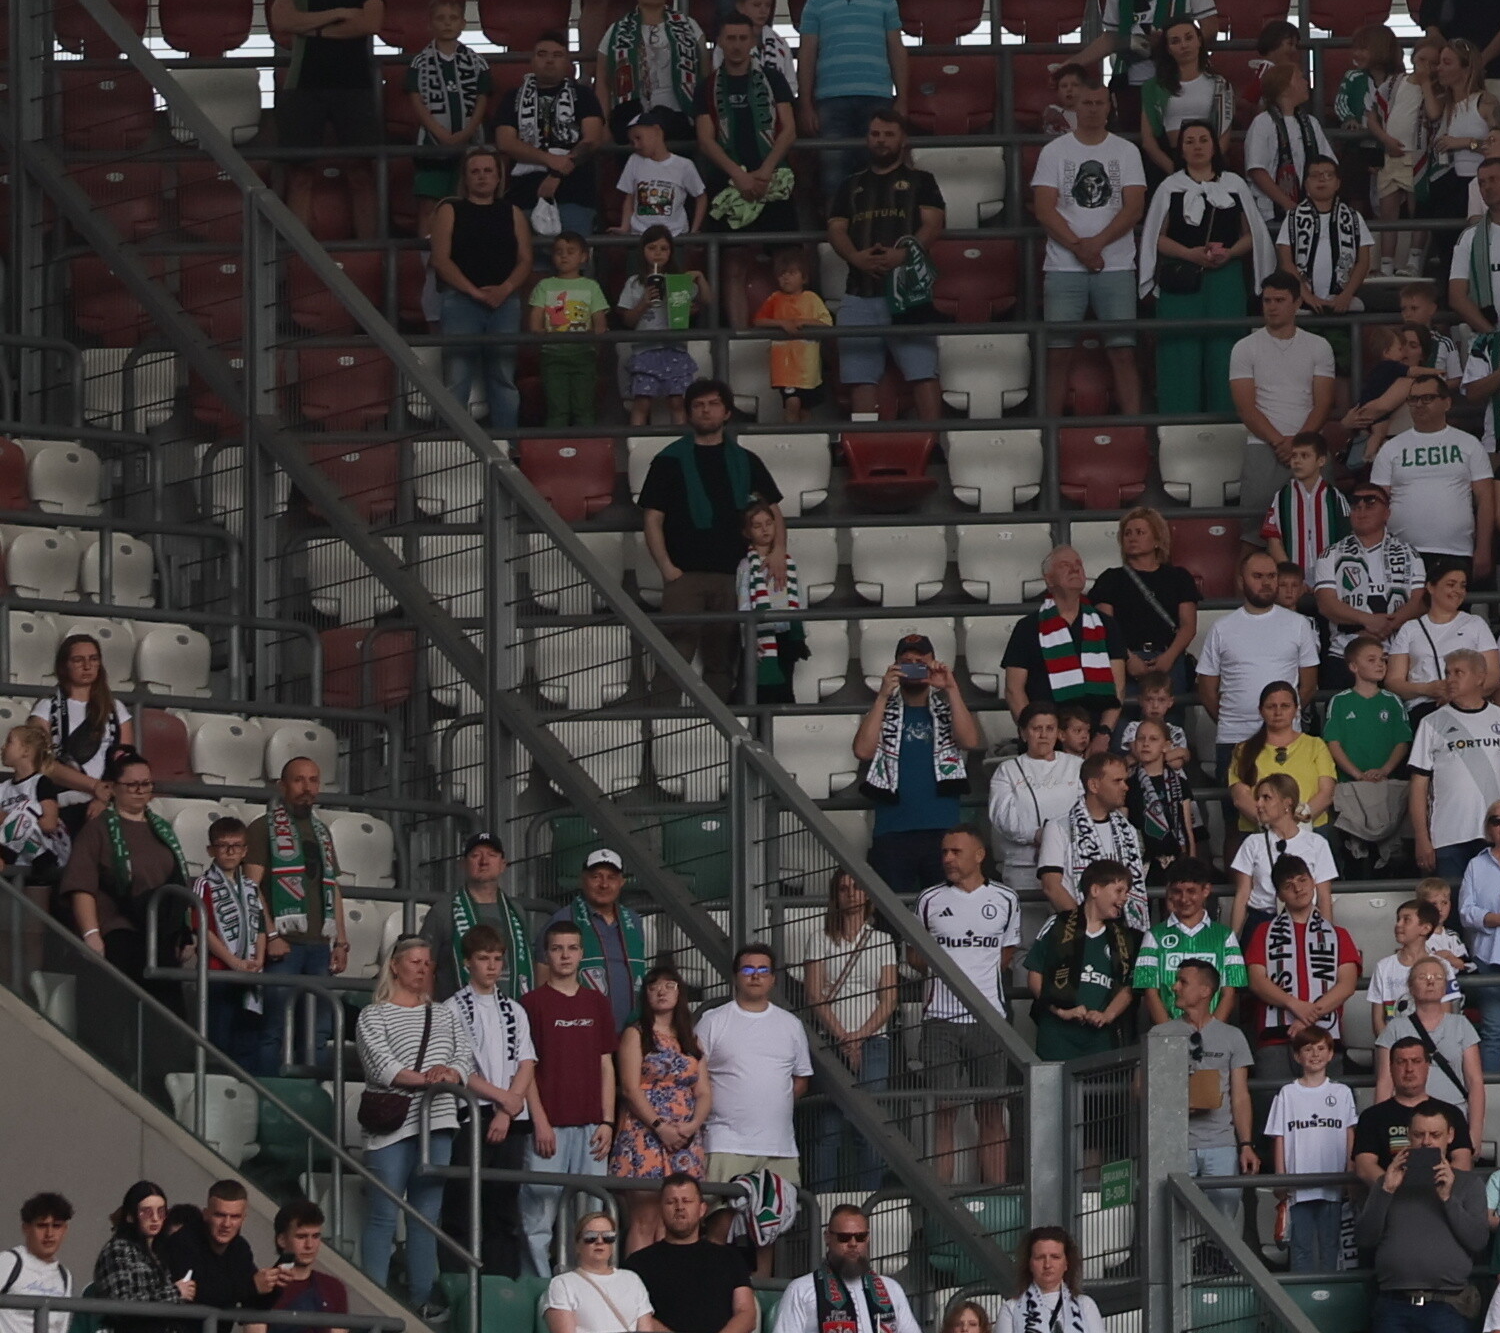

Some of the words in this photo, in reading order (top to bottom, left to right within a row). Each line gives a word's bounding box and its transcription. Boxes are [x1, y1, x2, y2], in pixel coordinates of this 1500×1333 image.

[1401, 445, 1464, 467] LEGIA
[937, 935, 999, 949] Plus500
[1311, 942, 1335, 982] NIE
[1287, 1118, 1342, 1132] Plus500
